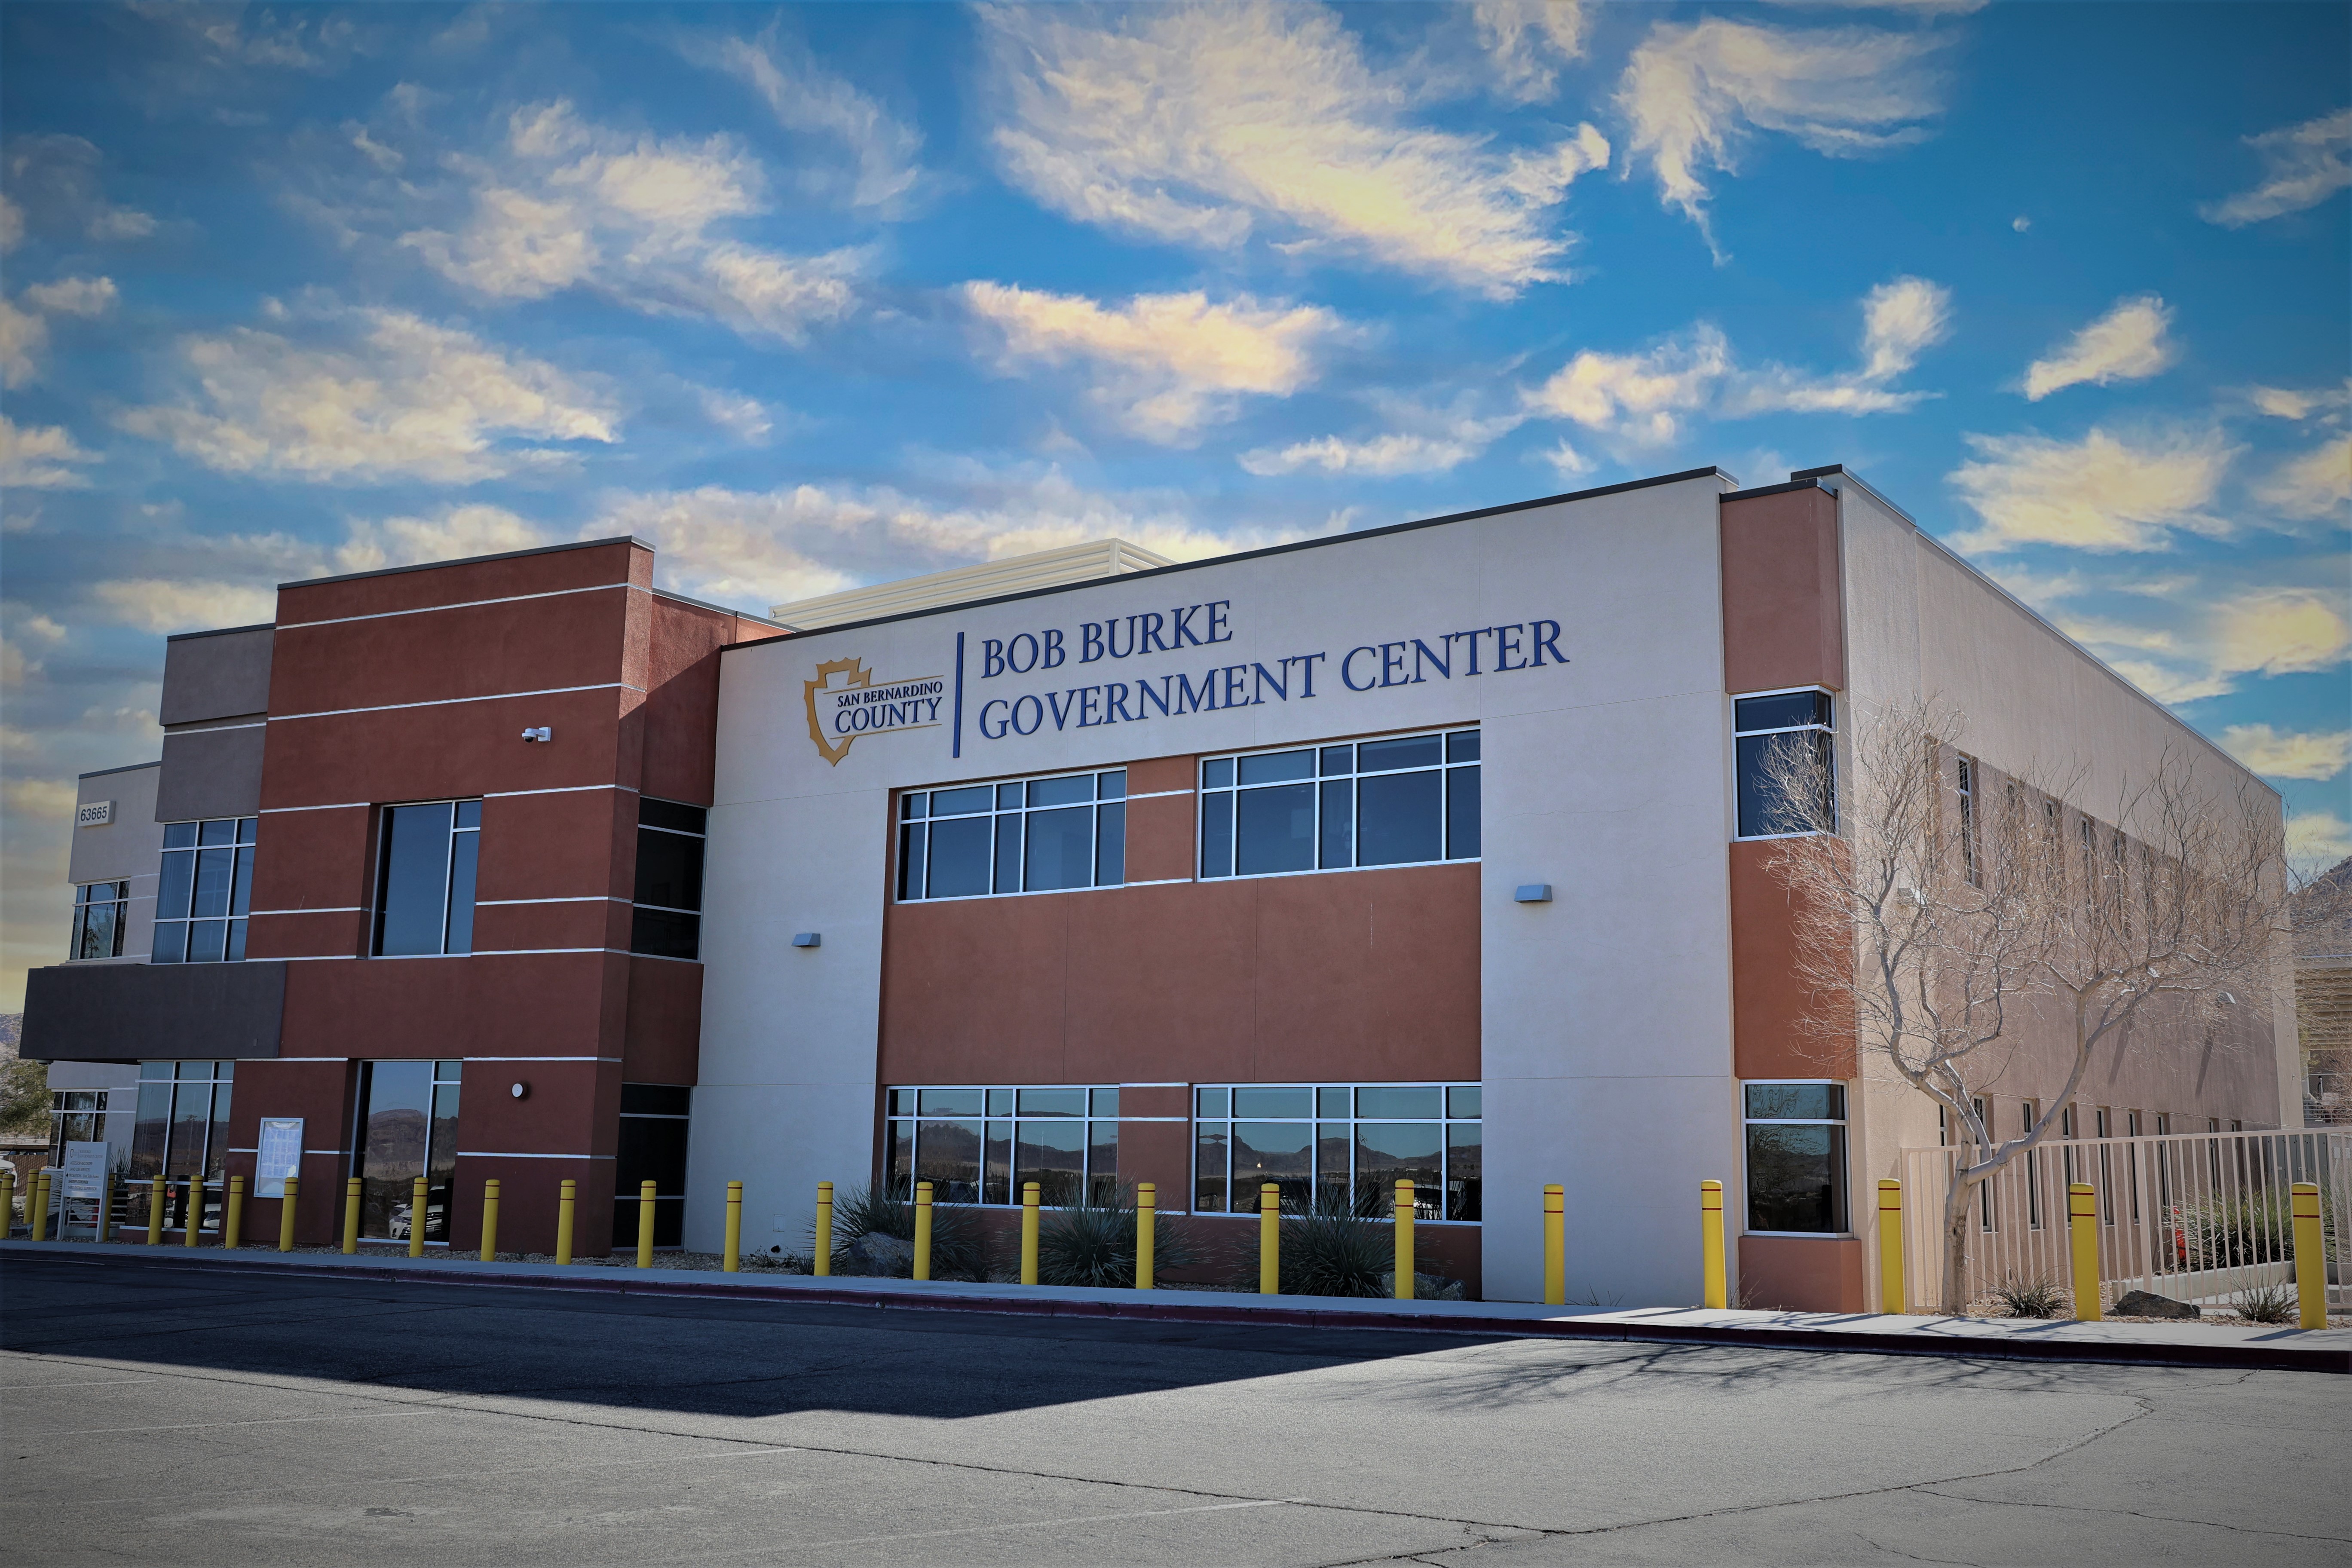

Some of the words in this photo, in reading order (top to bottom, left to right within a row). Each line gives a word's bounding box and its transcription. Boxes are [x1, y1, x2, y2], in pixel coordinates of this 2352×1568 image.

[980, 629, 1066, 679] BOB
[1078, 600, 1233, 664] BURKE
[838, 693, 860, 707] SAN
[863, 681, 943, 704] BERNARDINO
[979, 651, 1326, 740] GOVERNMENT
[1341, 619, 1571, 692] CENTER
[835, 696, 943, 733] COUNTY
[81, 806, 107, 821] 63665
